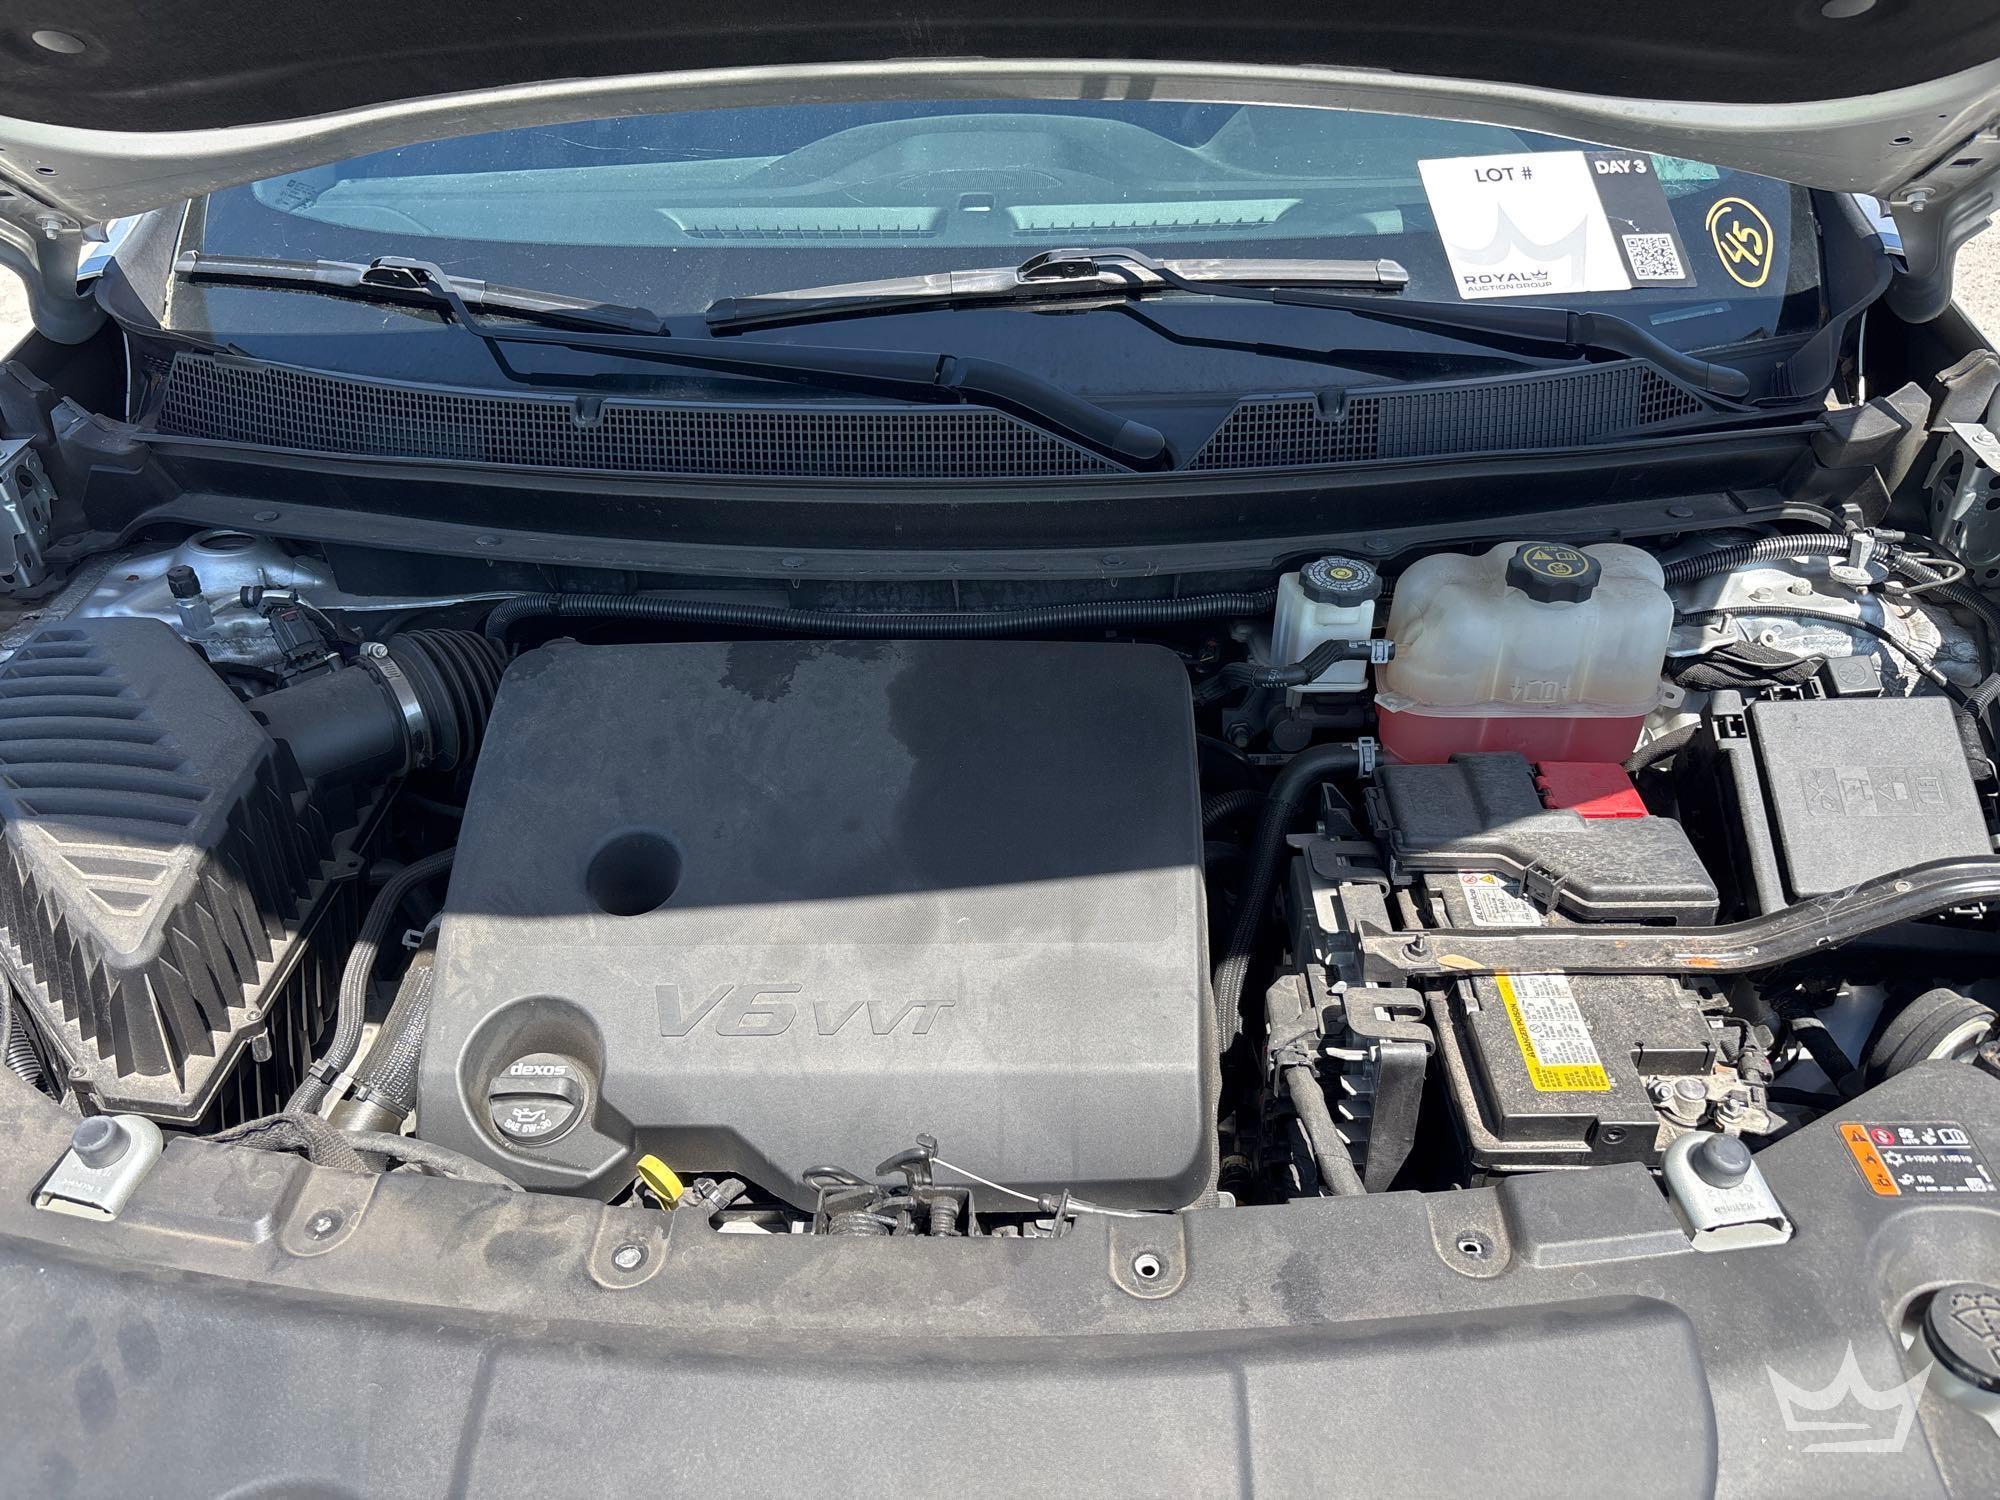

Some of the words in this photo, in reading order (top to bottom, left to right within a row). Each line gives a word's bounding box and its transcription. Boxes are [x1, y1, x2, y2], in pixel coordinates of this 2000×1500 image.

[1594, 159, 1631, 174] DAY
[1633, 159, 1647, 174] 3
[1474, 167, 1514, 183] LOT
[1521, 166, 1533, 180] #
[1720, 220, 1763, 267] 45
[1463, 272, 1532, 284] ROYAL
[1467, 283, 1514, 292] AUCTION
[1515, 281, 1552, 290] GROUP
[655, 984, 803, 1037] V6
[812, 1000, 956, 1036] VVT
[510, 1062, 569, 1076] dexos
[504, 1118, 521, 1132] SAE
[521, 1118, 552, 1133] 5W-30
